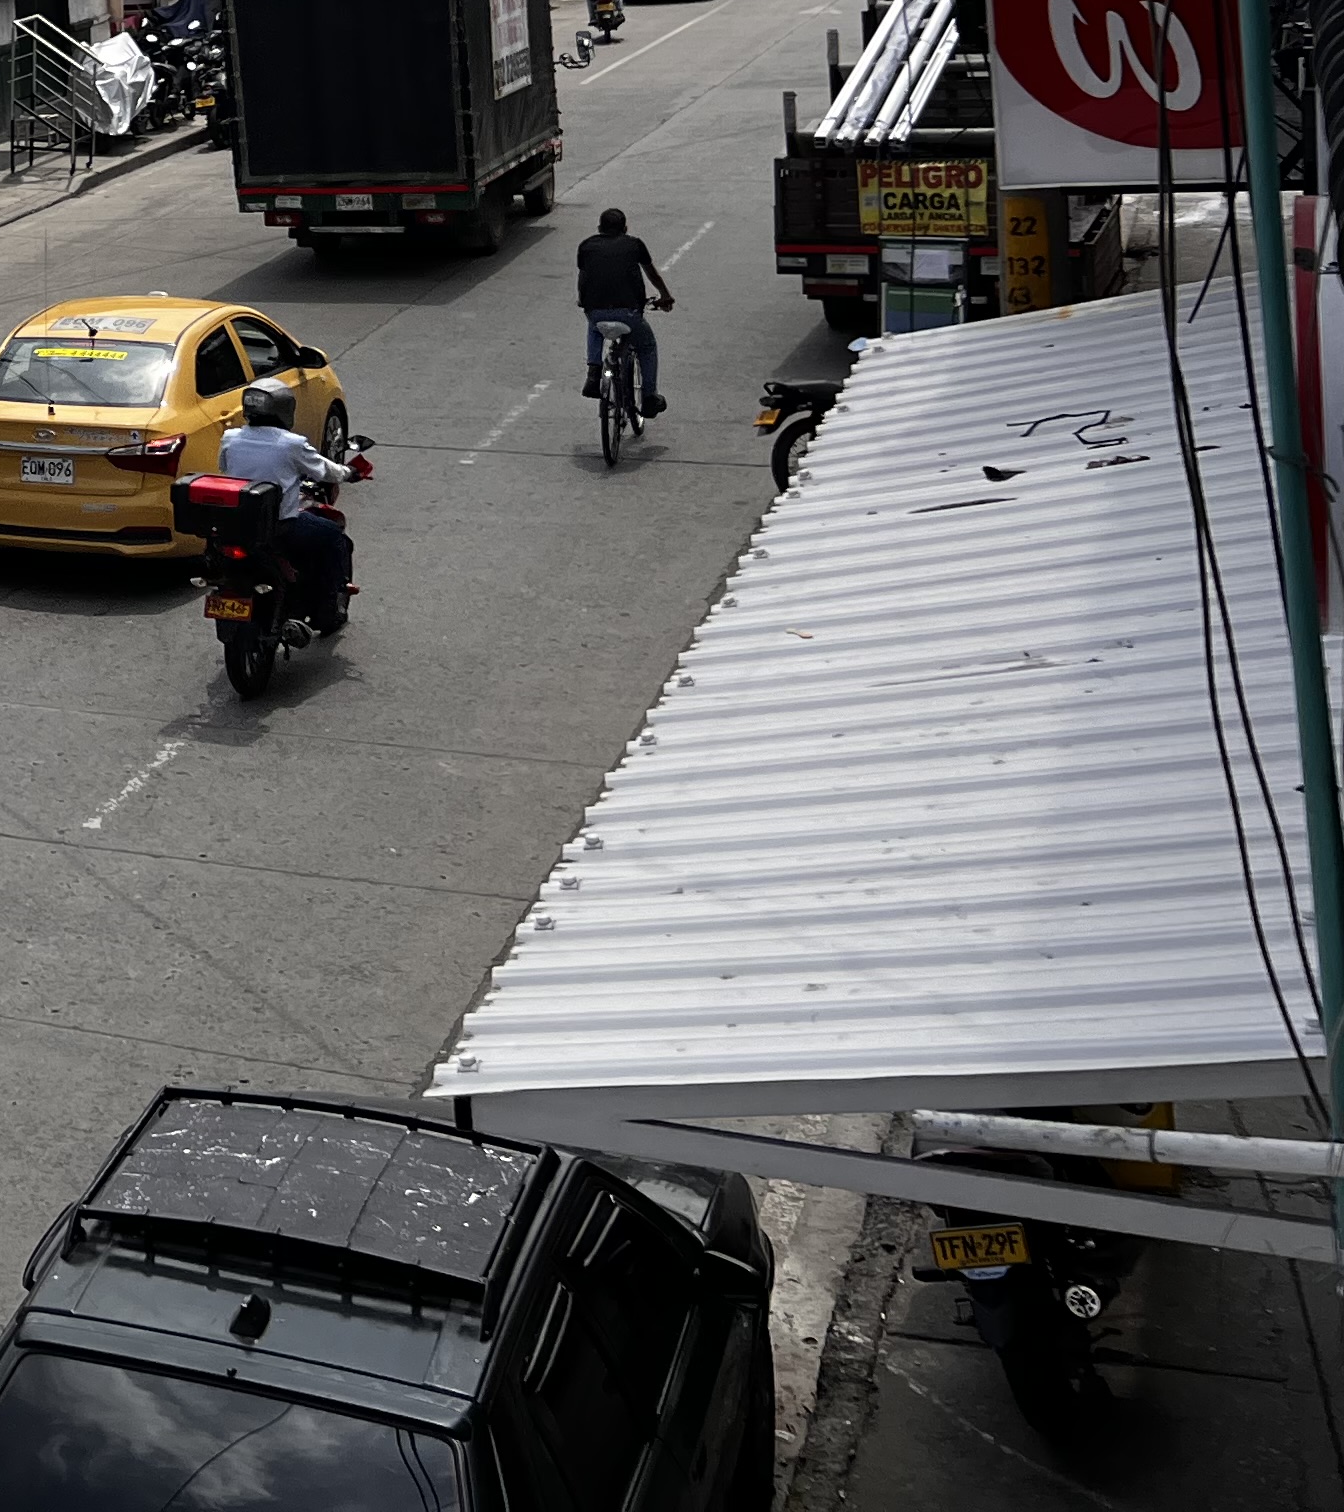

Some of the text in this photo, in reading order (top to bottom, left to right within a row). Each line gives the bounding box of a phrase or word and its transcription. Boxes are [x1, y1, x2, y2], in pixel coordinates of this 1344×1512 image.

[861, 164, 983, 189] PELIGRO
[884, 192, 961, 210] CARGA
[1010, 216, 1037, 236] 22
[1008, 255, 1045, 277] 132
